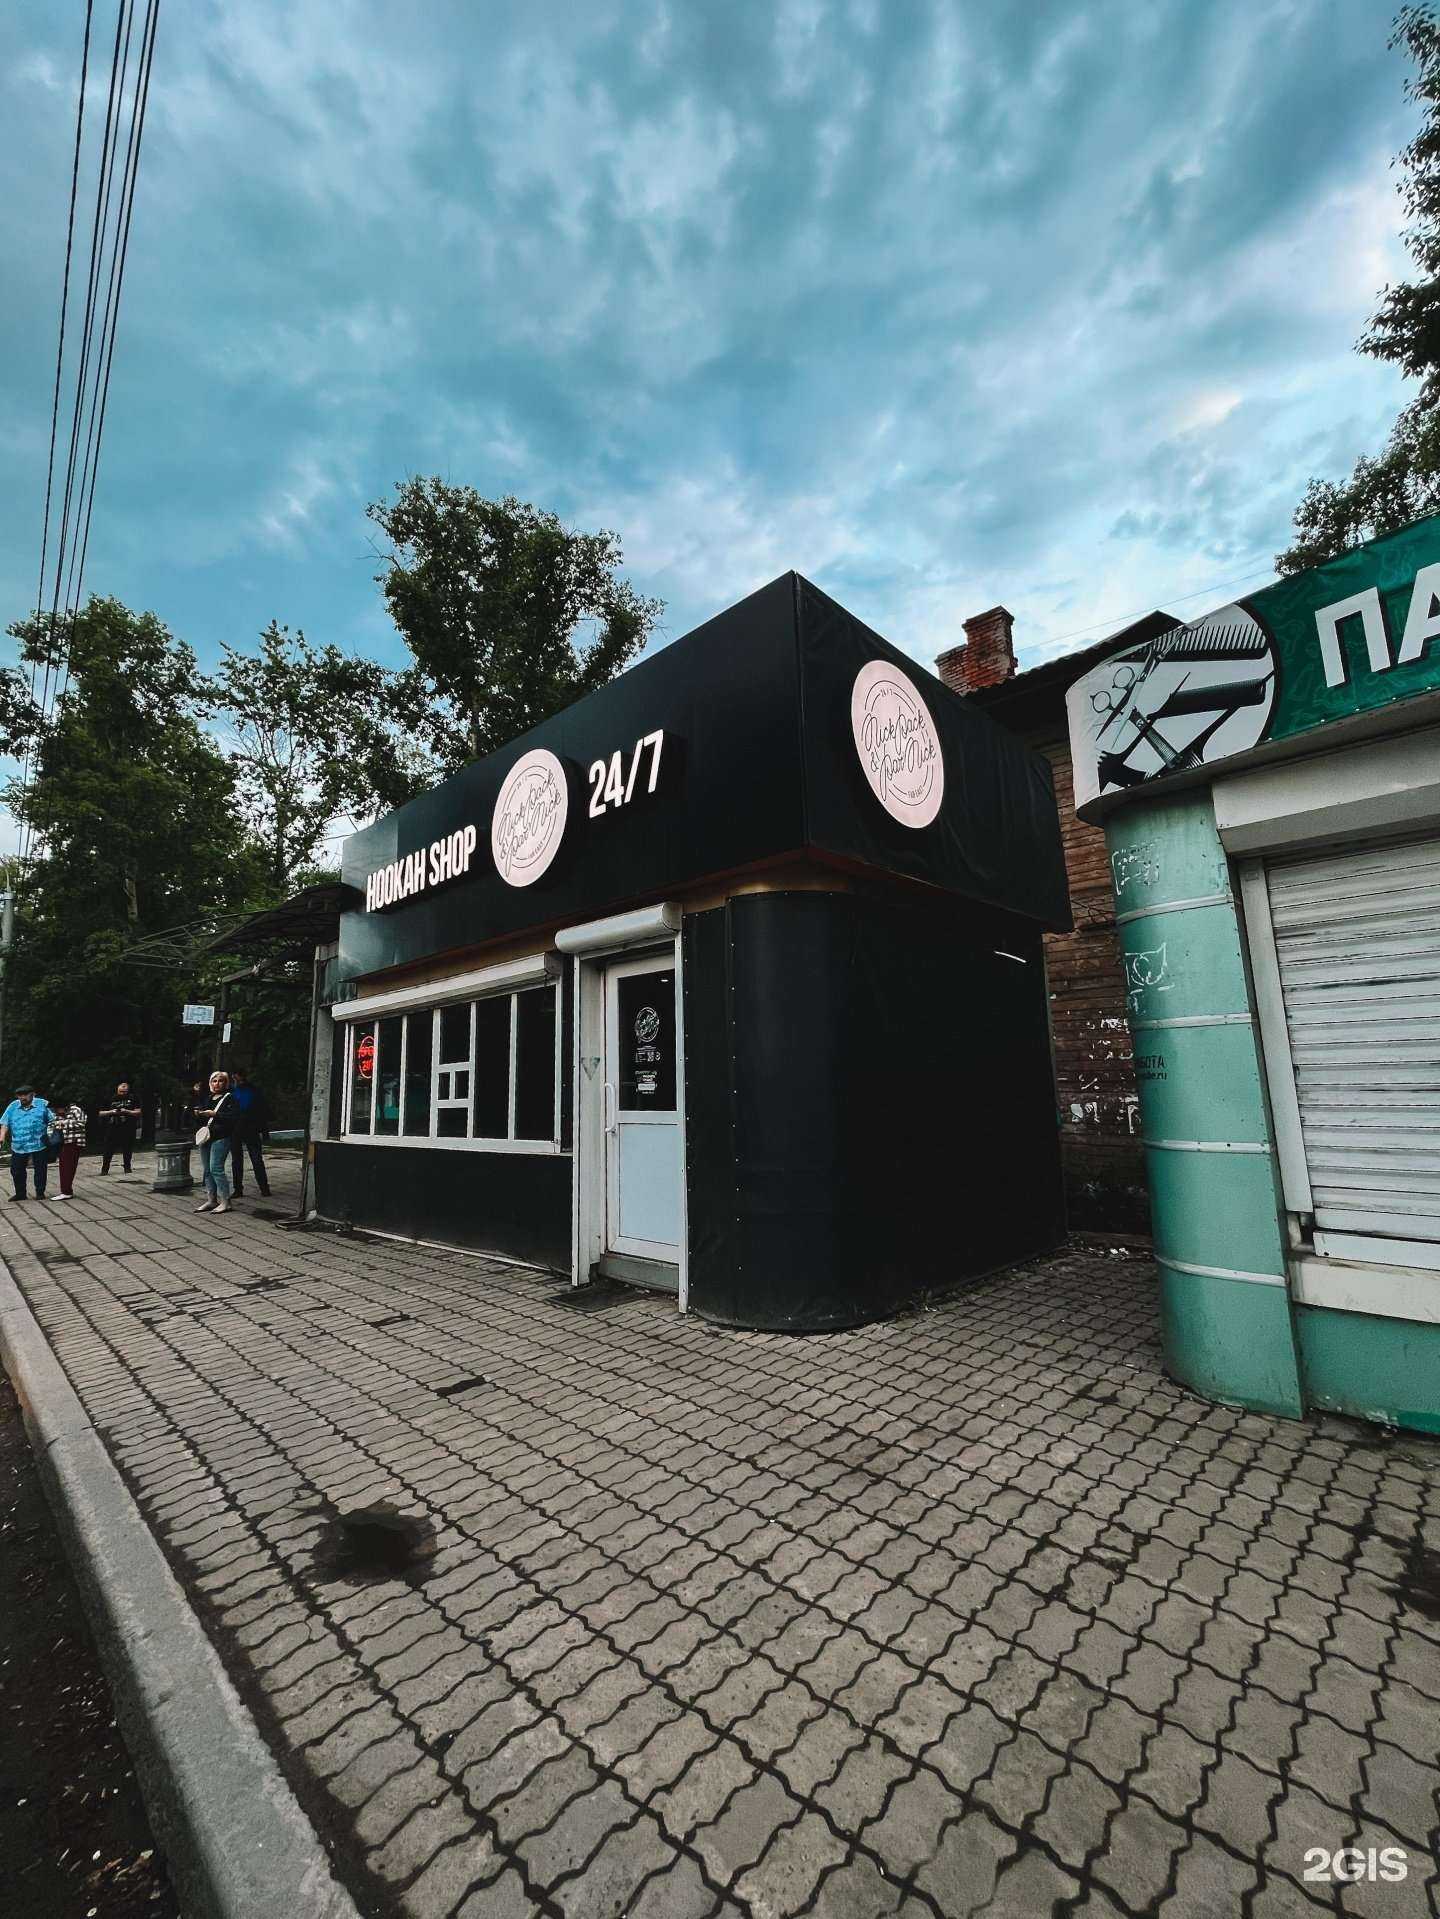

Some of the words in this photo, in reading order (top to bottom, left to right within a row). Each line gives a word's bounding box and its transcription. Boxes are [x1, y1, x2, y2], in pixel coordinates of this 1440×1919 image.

[1315, 562, 1440, 688] ПА
[588, 728, 664, 818] 24/7
[365, 846, 426, 913] HOOKAH
[428, 824, 477, 886] SHOP
